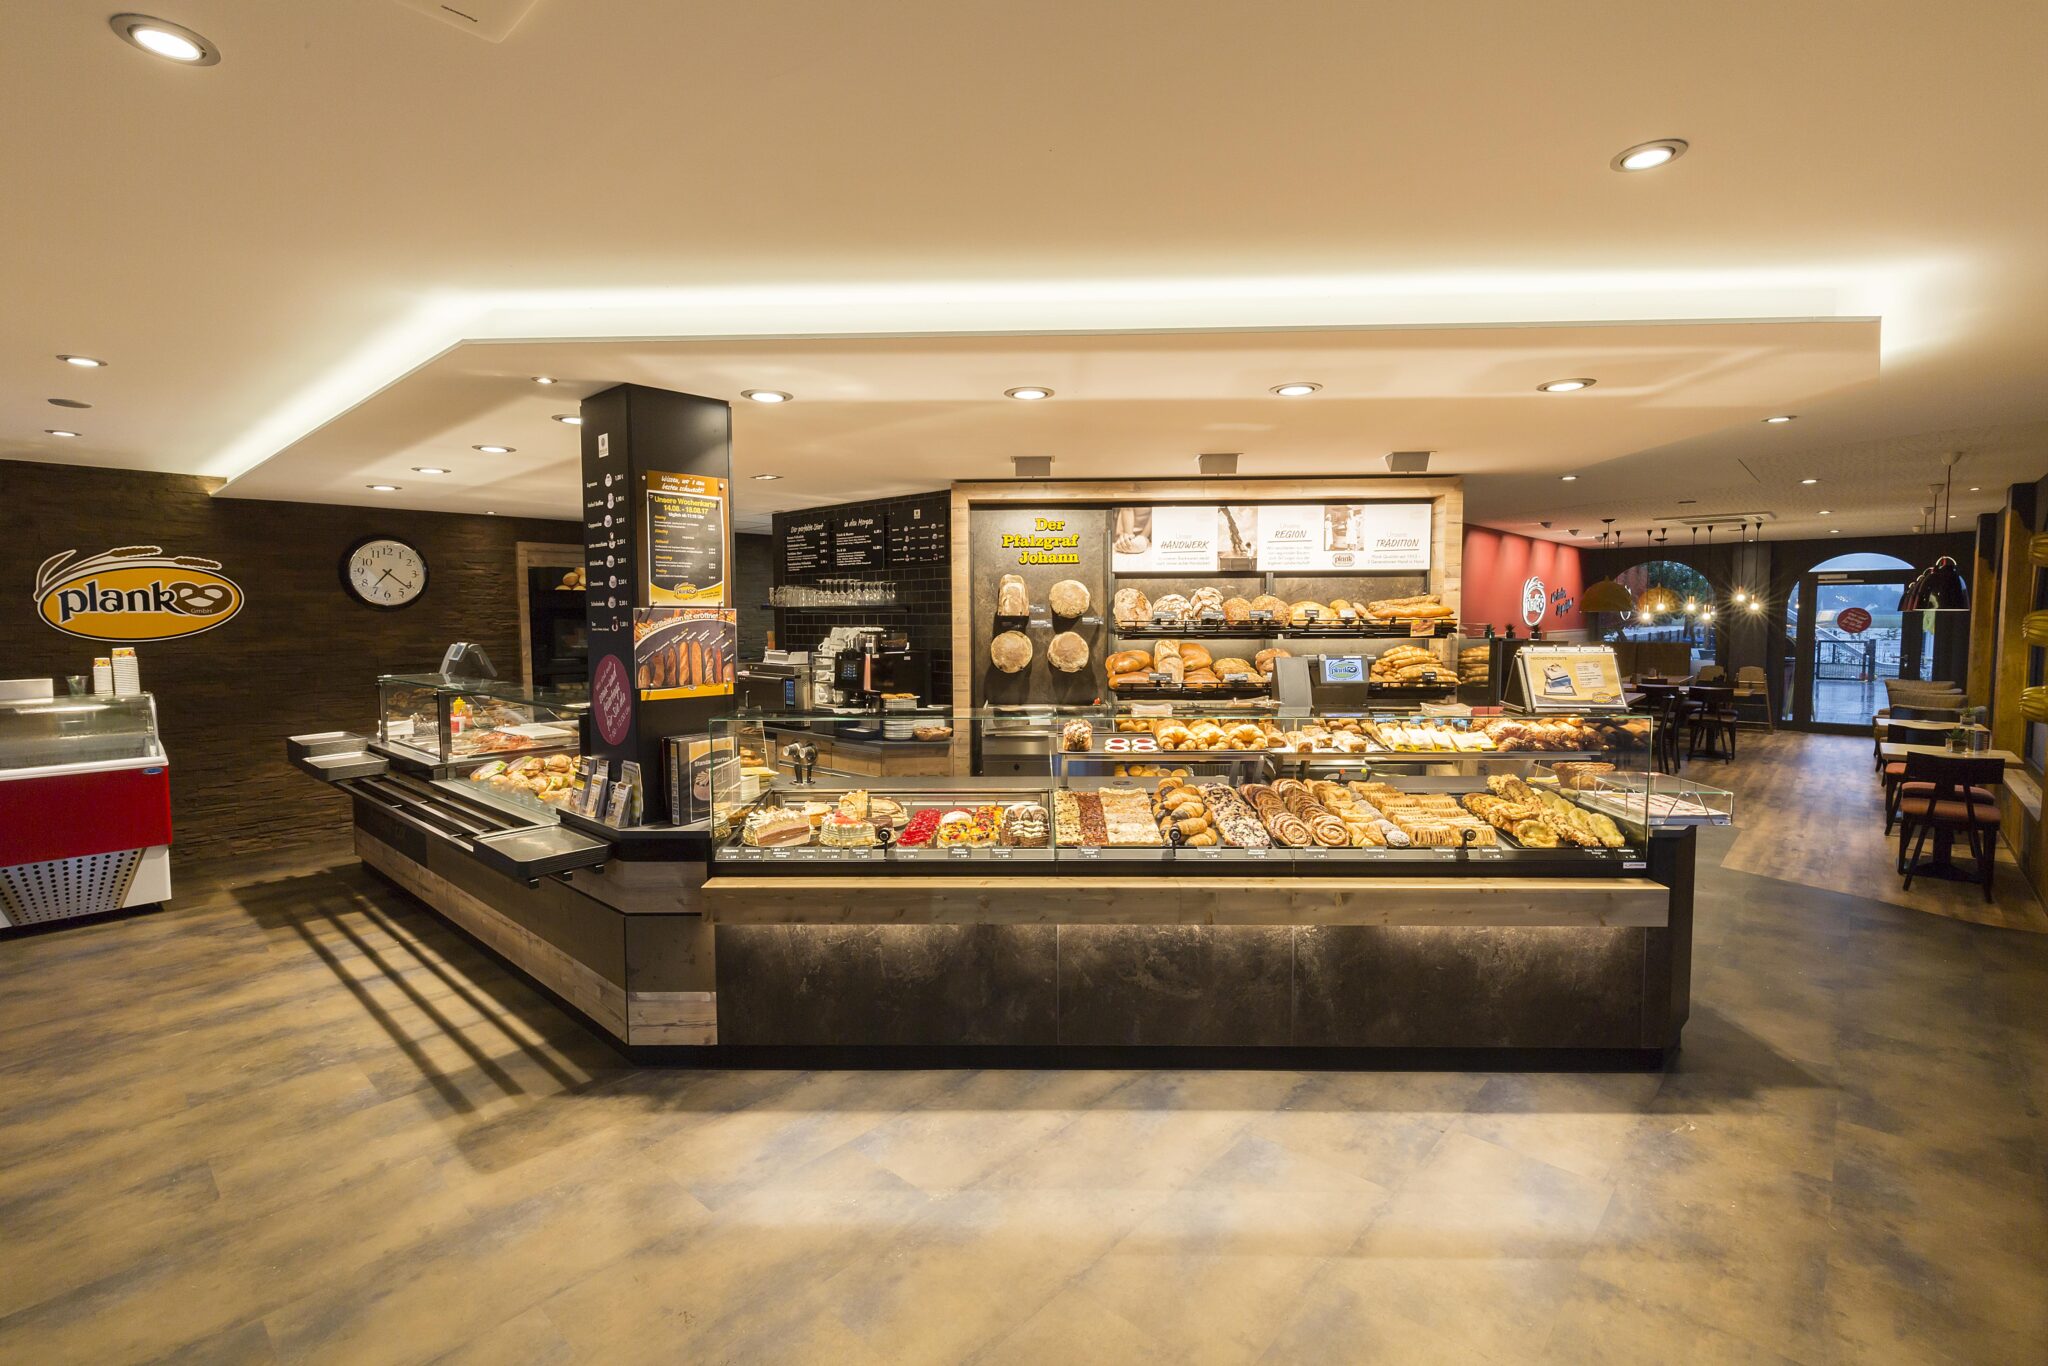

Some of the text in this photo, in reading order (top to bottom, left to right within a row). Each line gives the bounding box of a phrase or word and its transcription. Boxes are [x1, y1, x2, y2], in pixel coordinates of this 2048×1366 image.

[654, 496, 677, 504] Unsere
[1035, 517, 1065, 531] Der
[1274, 530, 1307, 538] REGION
[1002, 533, 1079, 550] Pfalzgraf
[1161, 540, 1210, 549] HANDWERK
[1376, 538, 1419, 548] TRADITION
[372, 550, 380, 558] 11
[382, 548, 393, 556] 12
[1019, 551, 1080, 565] Johann
[362, 579, 368, 587] 8
[399, 588, 404, 598] 5
[57, 580, 187, 623] plank
